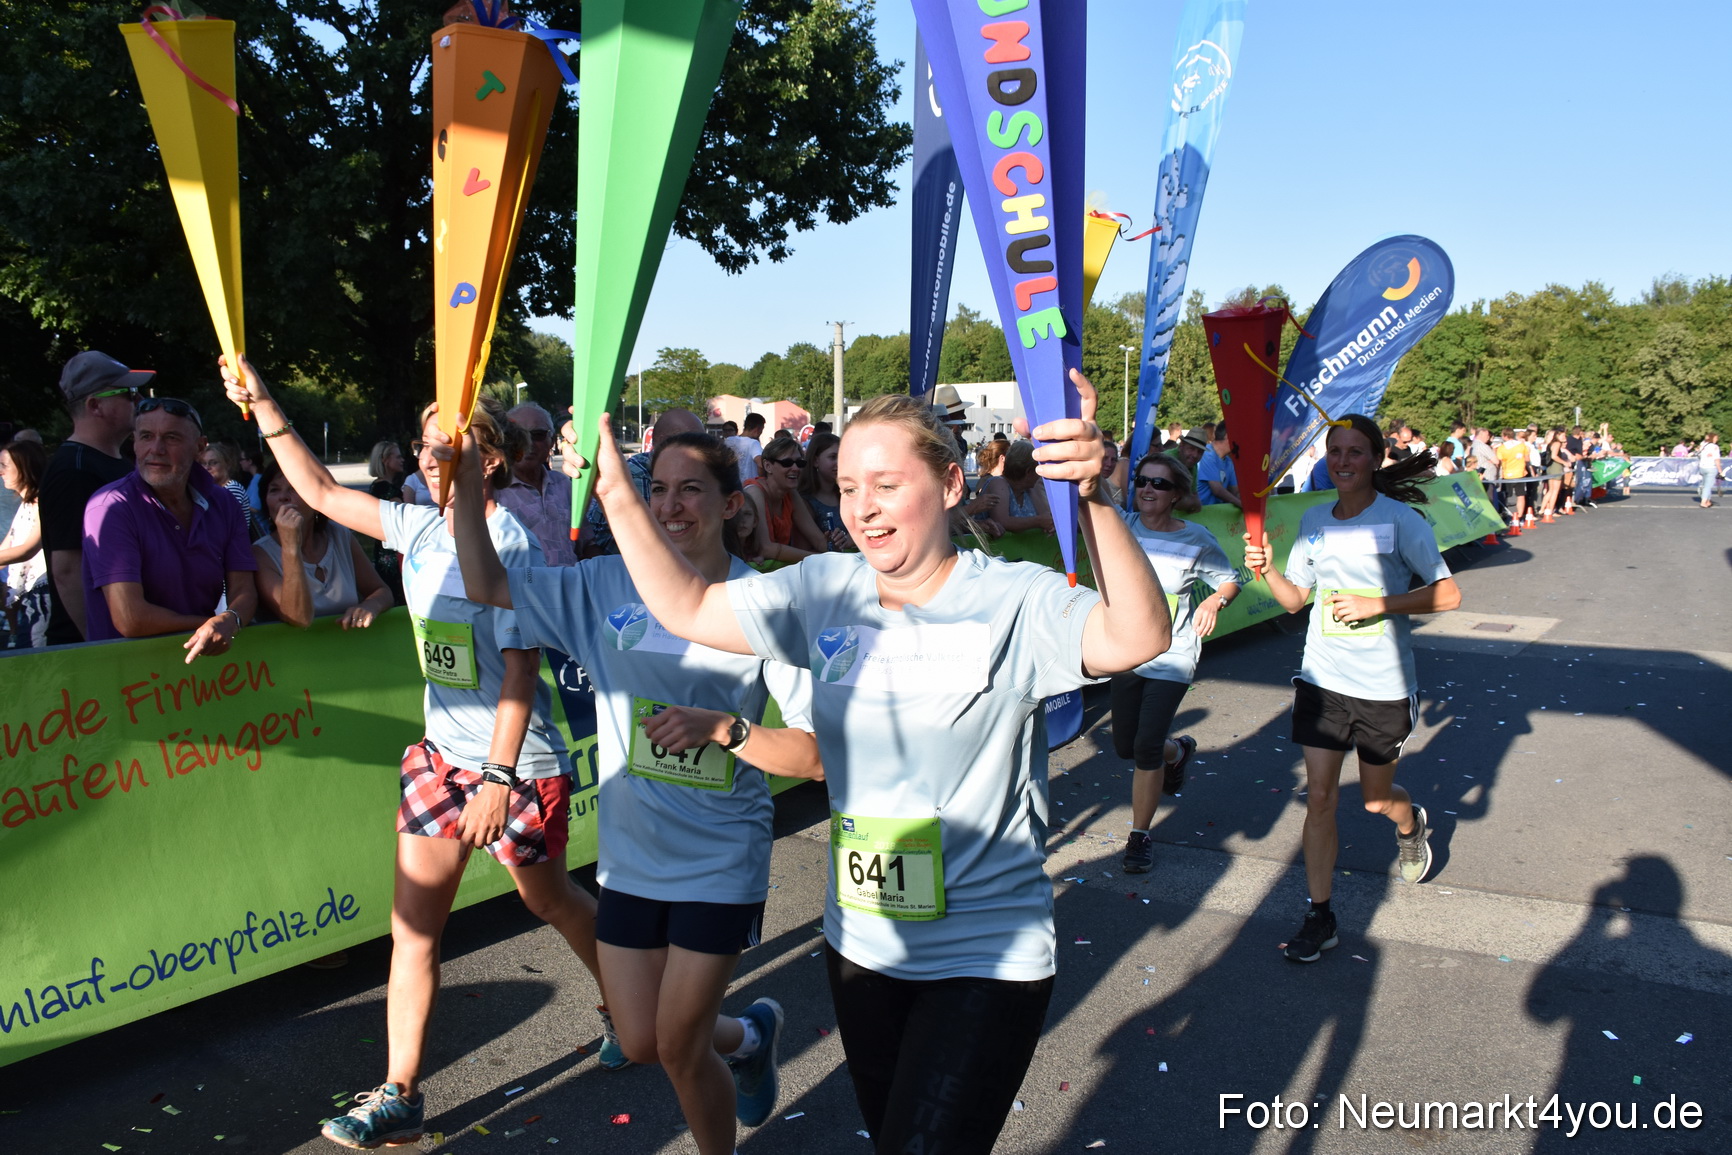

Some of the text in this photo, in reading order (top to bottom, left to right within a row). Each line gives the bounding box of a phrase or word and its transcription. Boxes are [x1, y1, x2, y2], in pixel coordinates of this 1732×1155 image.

[1357, 286, 1443, 367] Druck und Medien
[1284, 305, 1399, 418] Frischmann
[423, 640, 456, 670] 649
[0, 660, 276, 759] nde Firmen
[158, 689, 322, 780] länger!
[655, 760, 702, 775] Frank Maria
[848, 850, 906, 892] 641
[856, 887, 905, 903] Gabel Maria
